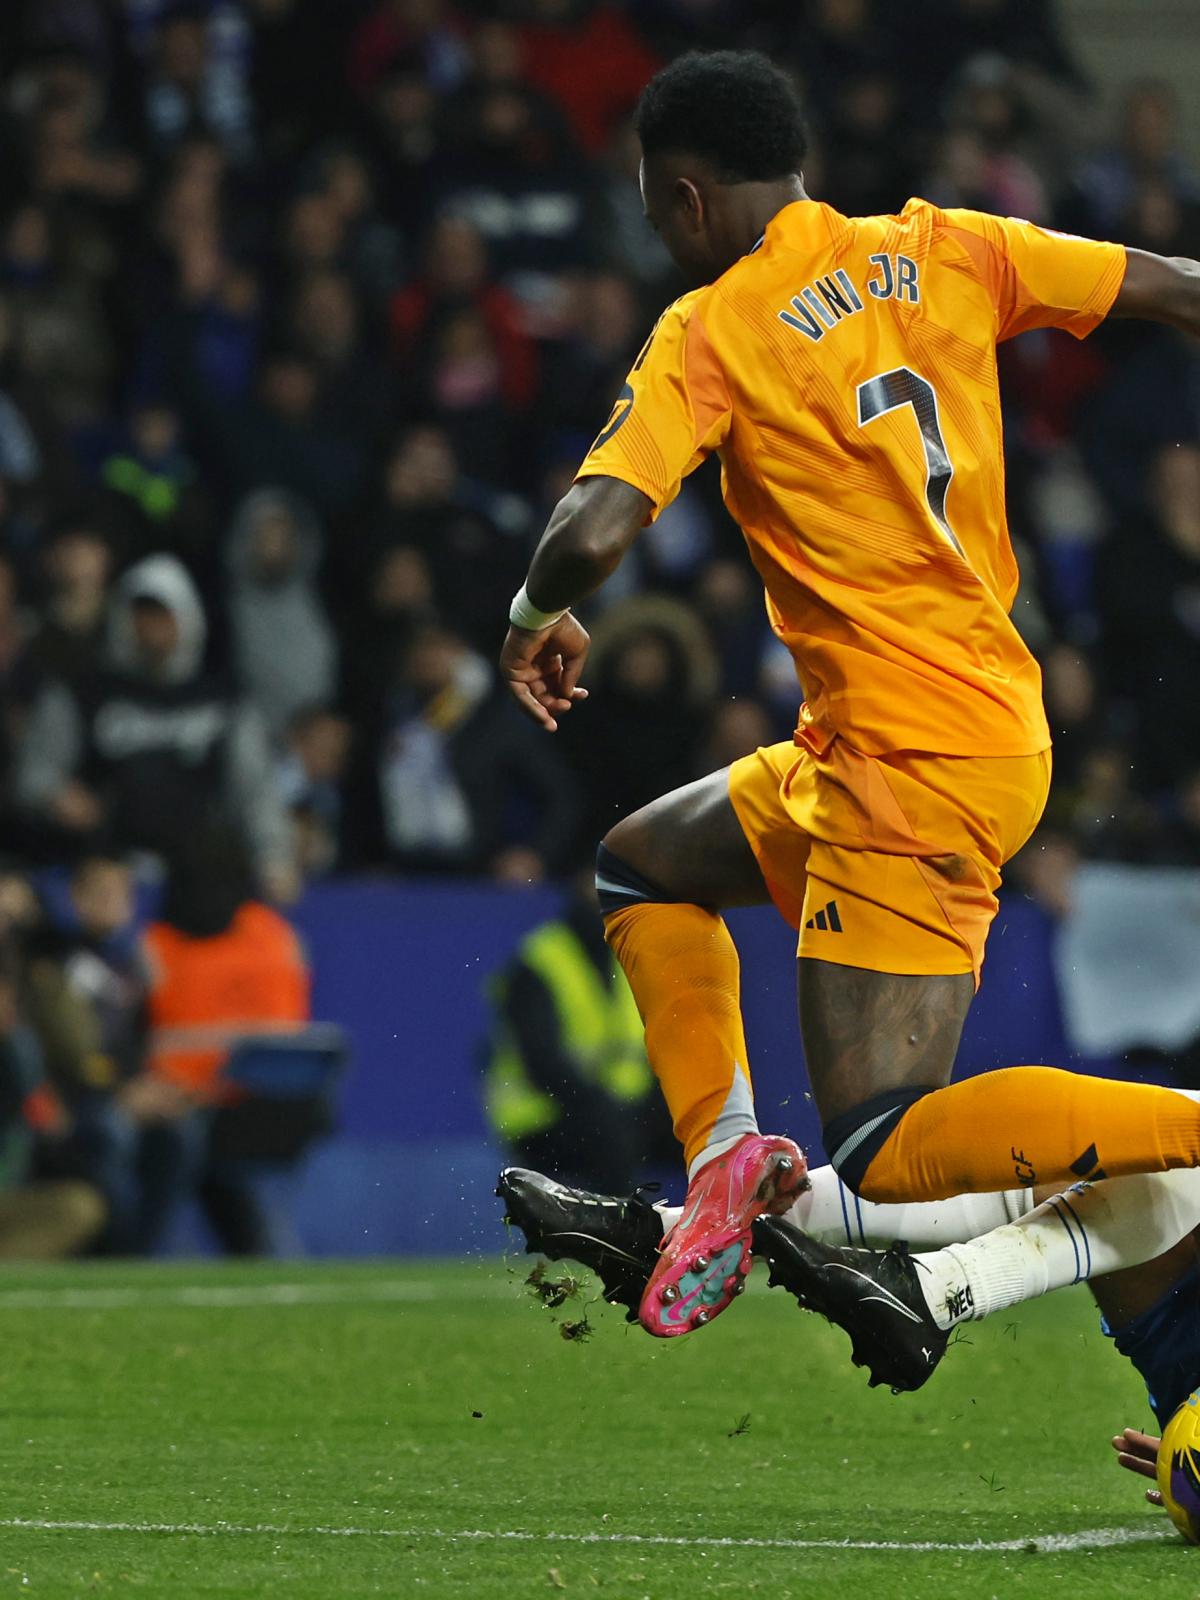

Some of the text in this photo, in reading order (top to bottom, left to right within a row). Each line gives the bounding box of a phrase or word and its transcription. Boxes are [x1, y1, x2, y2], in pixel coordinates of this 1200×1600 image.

[778, 252, 919, 343] VINI JR
[856, 365, 974, 572] 7
